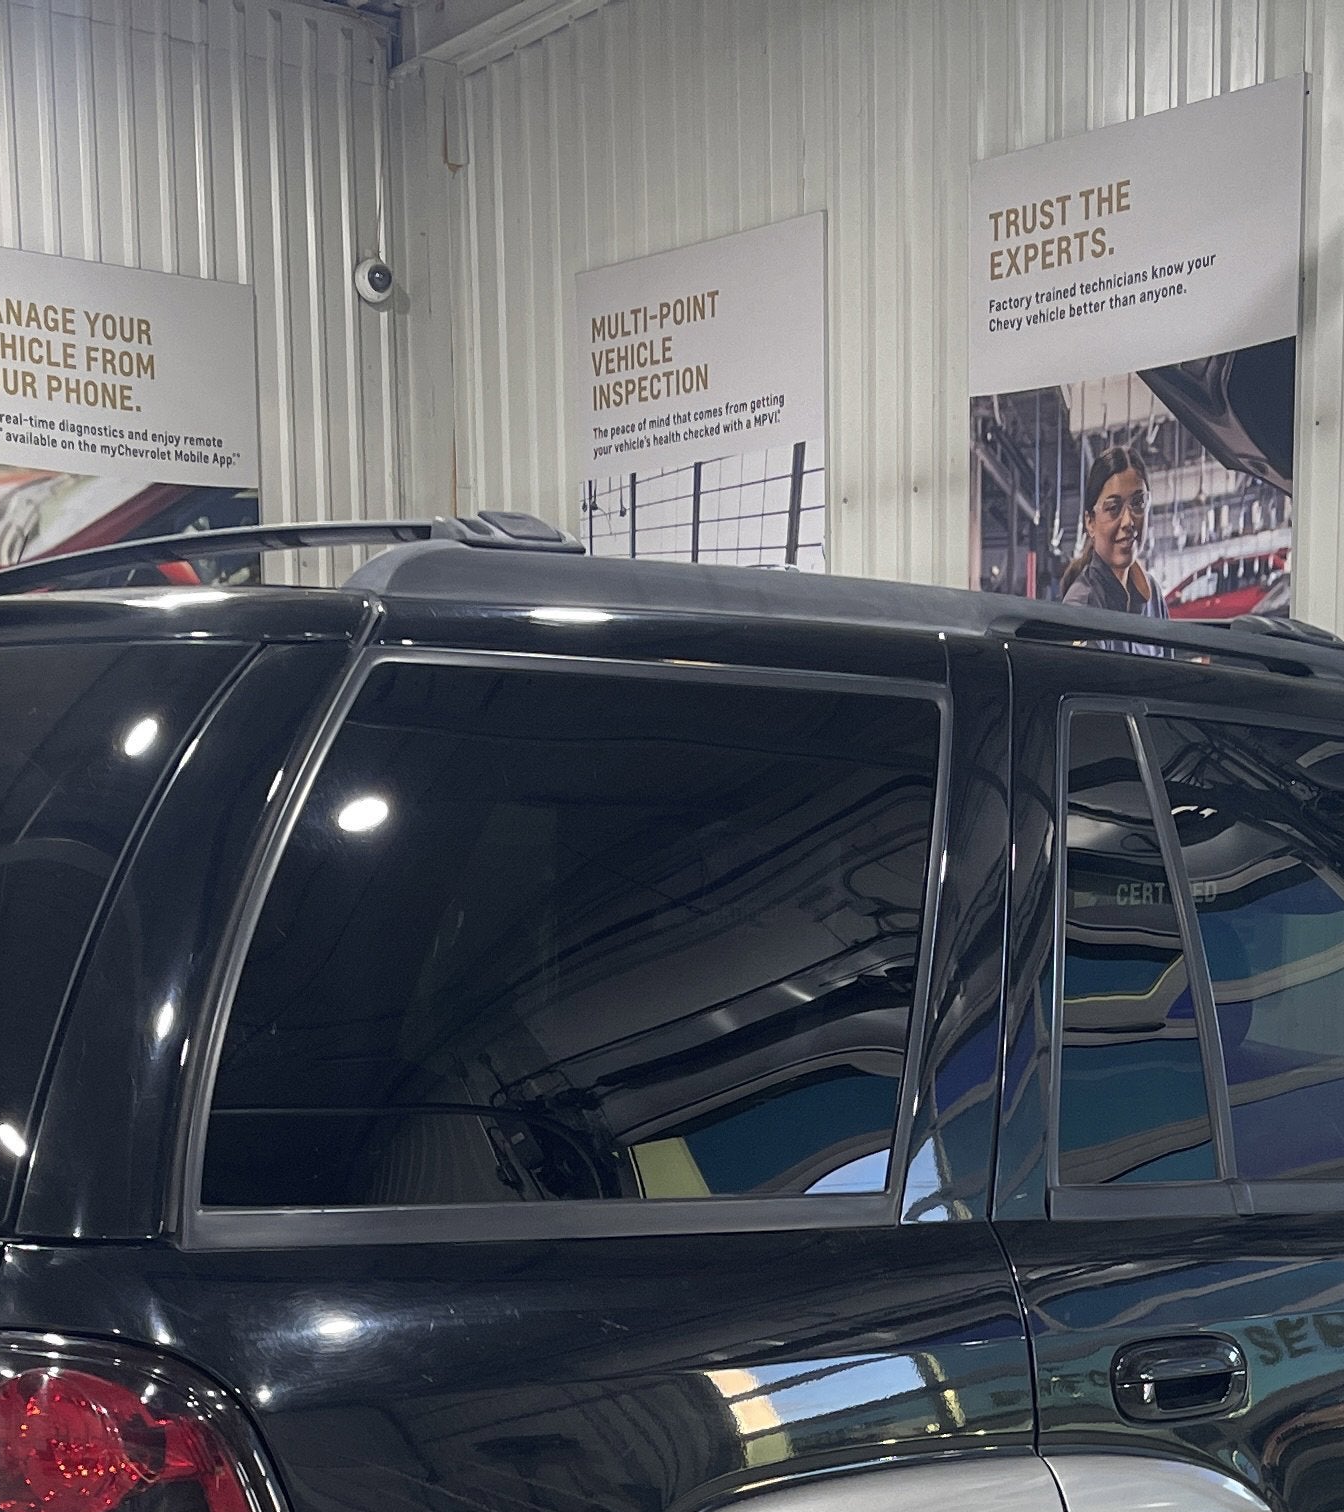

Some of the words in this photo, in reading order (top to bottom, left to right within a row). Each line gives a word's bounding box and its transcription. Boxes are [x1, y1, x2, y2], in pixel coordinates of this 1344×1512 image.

[988, 194, 1072, 241] TRUST
[1078, 179, 1131, 222] THE
[989, 227, 1115, 281] EXPERTS.
[988, 293, 1032, 314] Factory
[1034, 282, 1077, 304] trained
[1079, 267, 1148, 297] technicians
[1151, 261, 1185, 280] know
[1187, 253, 1217, 276] your
[83, 310, 153, 346] YOUR
[591, 290, 720, 344] MULTI-POINT
[988, 316, 1023, 334] Chevy
[1025, 306, 1066, 328] vehicle
[1068, 299, 1106, 318] better
[1108, 294, 1137, 311] than
[1139, 282, 1187, 307] anyone.
[85, 346, 156, 381] FROM
[591, 336, 673, 377] VEHICLE
[46, 375, 142, 413] PHONE.
[592, 363, 709, 412] INSPECTION
[0, 412, 55, 431] real-time
[58, 419, 124, 440] diagnostics
[128, 428, 149, 443] and
[151, 430, 181, 450] enjoy
[183, 434, 223, 449] remote
[593, 426, 609, 441] The
[610, 422, 636, 441] peace
[637, 418, 647, 433] of
[648, 415, 671, 432] mind
[672, 411, 692, 427] that
[693, 407, 723, 423] comes
[725, 399, 749, 416] from
[750, 393, 785, 414] getting
[5, 430, 57, 449] available
[61, 438, 75, 451] on
[78, 437, 97, 453] the
[100, 442, 172, 462] myChevrolet
[174, 449, 210, 465] Mobile
[593, 444, 613, 461] your
[614, 435, 651, 454] vehicle's
[652, 429, 682, 446] health
[683, 424, 721, 442] checked
[722, 418, 744, 435] with
[745, 421, 752, 430] a
[1117, 882, 1217, 906] CERTED
